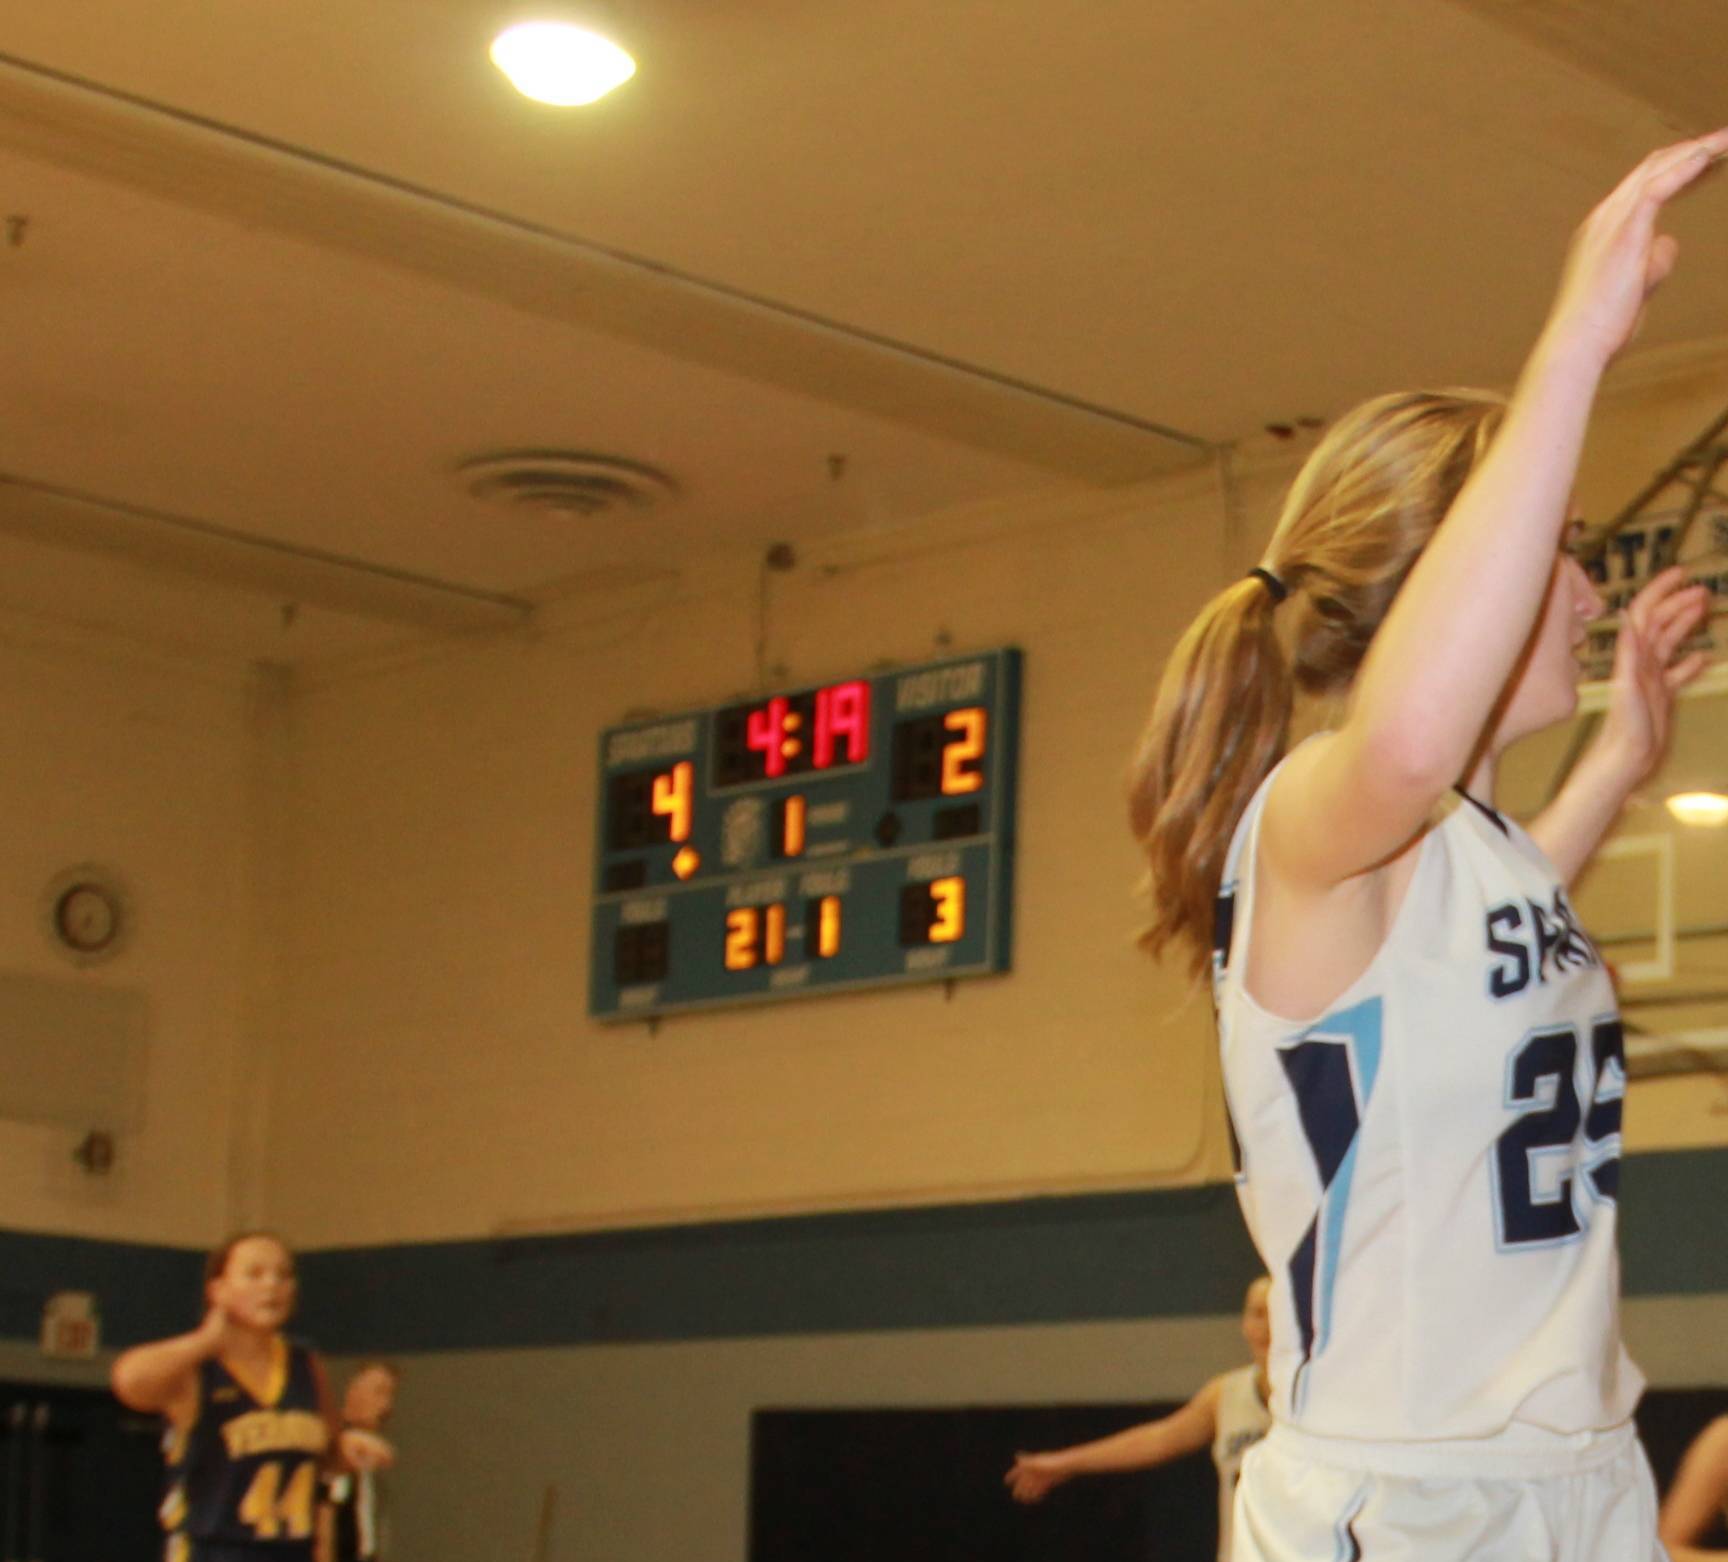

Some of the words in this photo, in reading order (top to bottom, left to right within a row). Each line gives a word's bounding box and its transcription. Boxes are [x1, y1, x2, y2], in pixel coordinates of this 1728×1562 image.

[941, 705, 988, 796] 2
[651, 760, 695, 844] 4
[783, 794, 807, 858] 1
[724, 901, 787, 973] 21
[818, 895, 842, 959] 1
[928, 875, 967, 944] 3
[238, 1460, 316, 1541] 44
